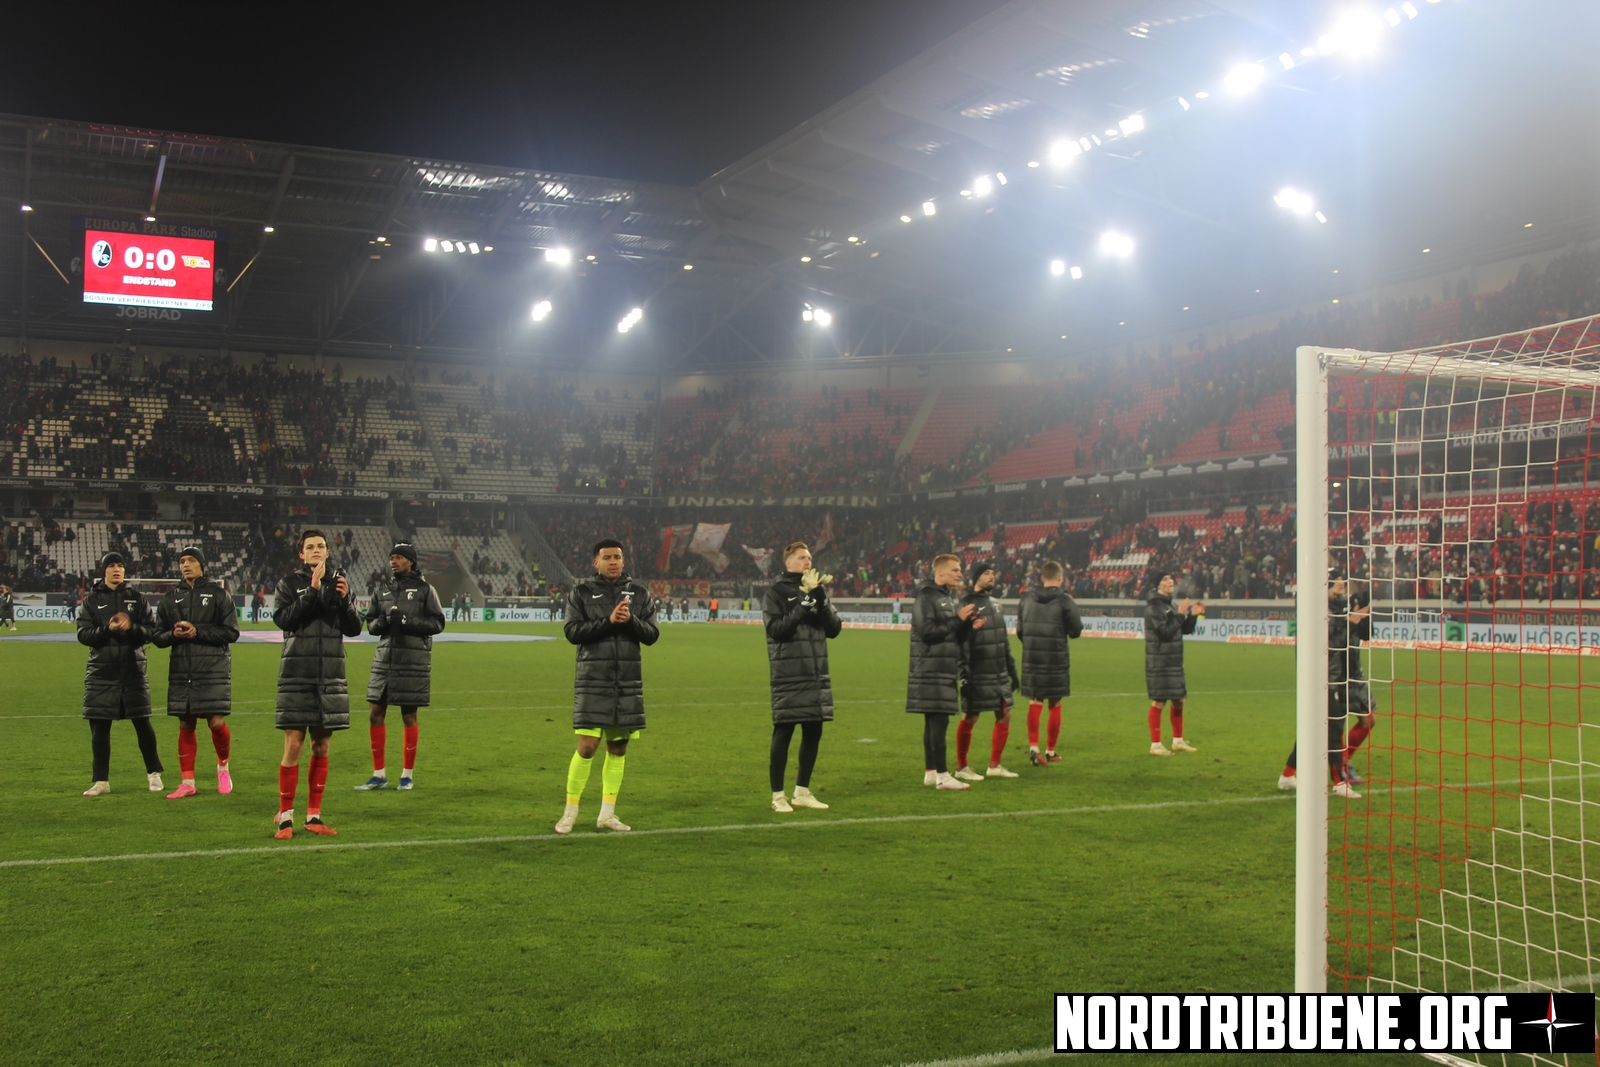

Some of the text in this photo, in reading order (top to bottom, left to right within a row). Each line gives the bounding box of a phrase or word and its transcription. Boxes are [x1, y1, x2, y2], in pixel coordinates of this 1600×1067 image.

[84, 218, 217, 238] EUROPA PARK Stadion
[124, 246, 176, 270] 0:0
[123, 275, 176, 287] ENDSTAND
[118, 296, 188, 307] VERTRIEBSPARTNER
[116, 306, 182, 320] JOBRAD
[1341, 445, 1368, 458] PARK
[226, 486, 264, 494] könig
[354, 490, 389, 498] könig
[668, 496, 754, 507] UNION
[16, 607, 69, 618] ÖRGERÄ
[500, 610, 529, 619] arlow
[1097, 619, 1143, 632] HÖRGERÄ
[1211, 622, 1281, 638] HÖRGERÄTE
[1373, 626, 1438, 641] RGERÄTE
[1471, 628, 1517, 643] arlow
